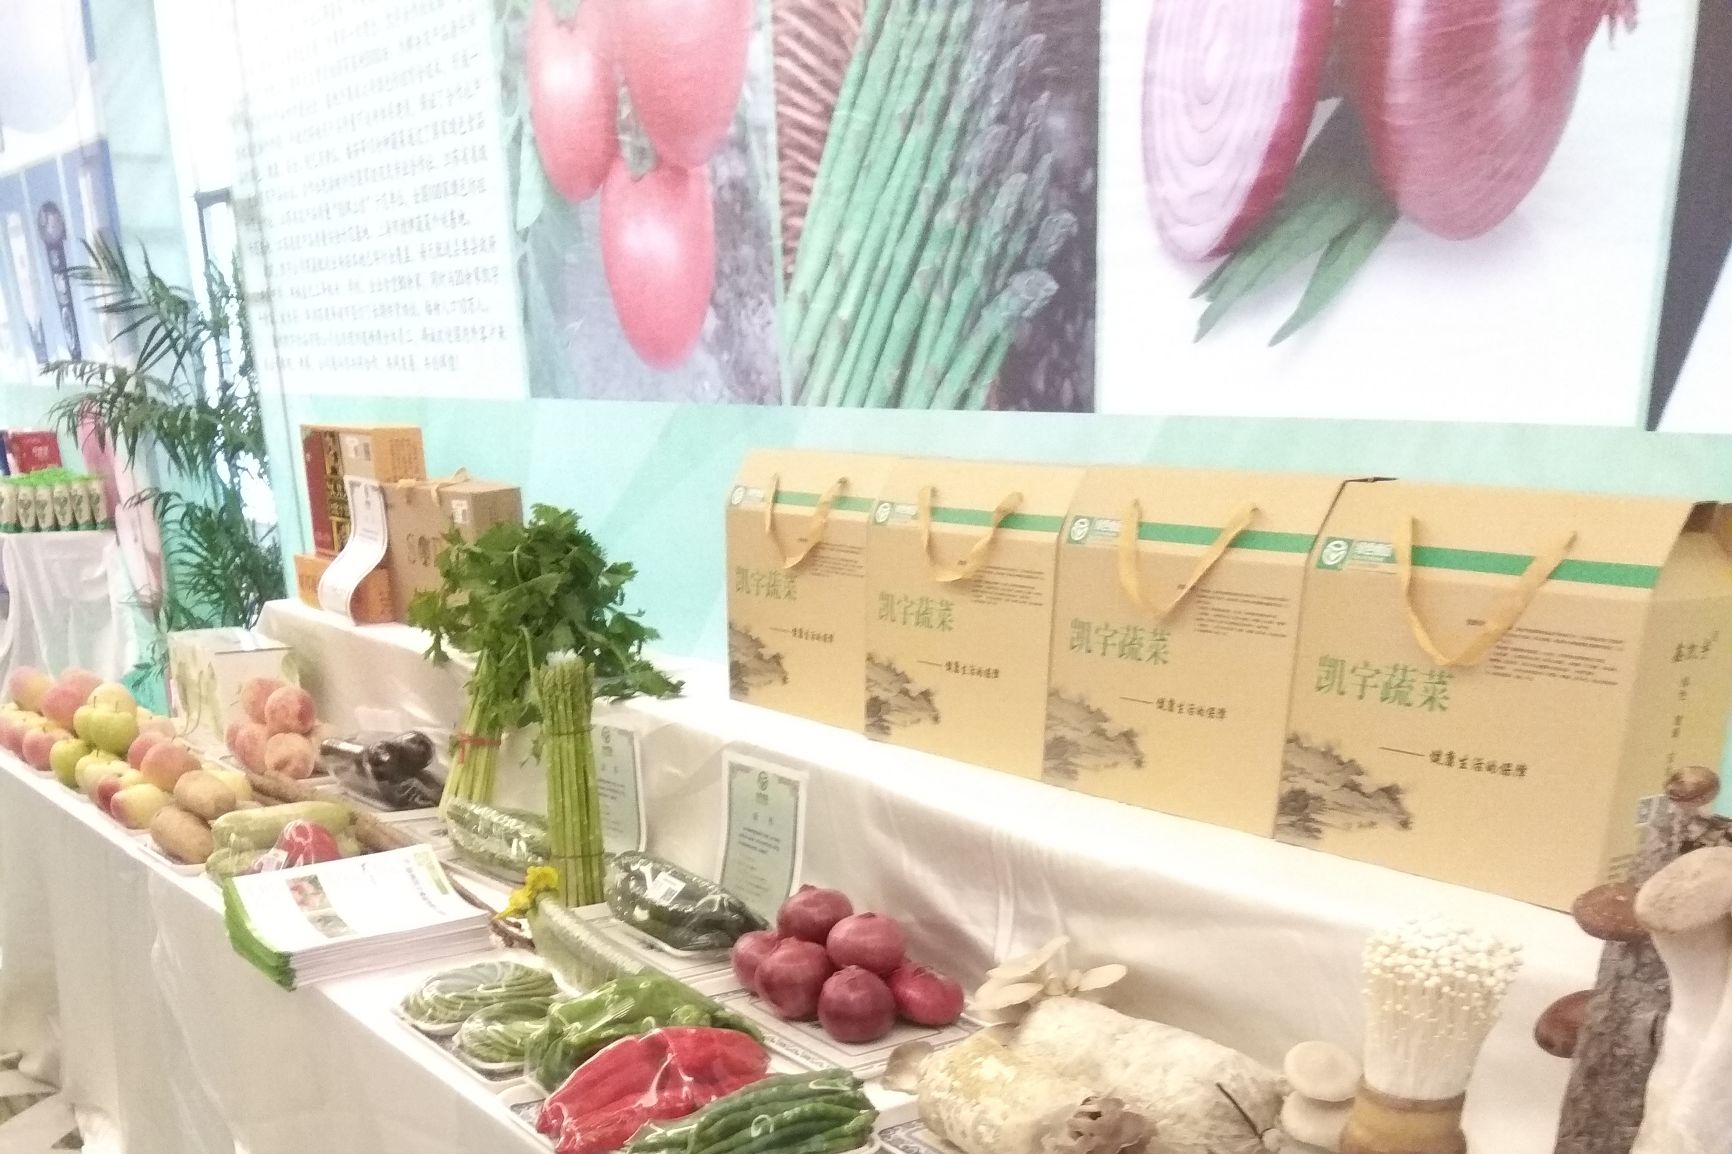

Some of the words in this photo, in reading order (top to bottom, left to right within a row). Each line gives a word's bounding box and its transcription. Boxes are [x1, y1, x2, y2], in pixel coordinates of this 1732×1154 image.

[878, 591, 955, 632] 凯宇蔬菜
[1069, 618, 1171, 665] 凯宇蔬菜
[1315, 655, 1455, 711] 凯宇蔬菜
